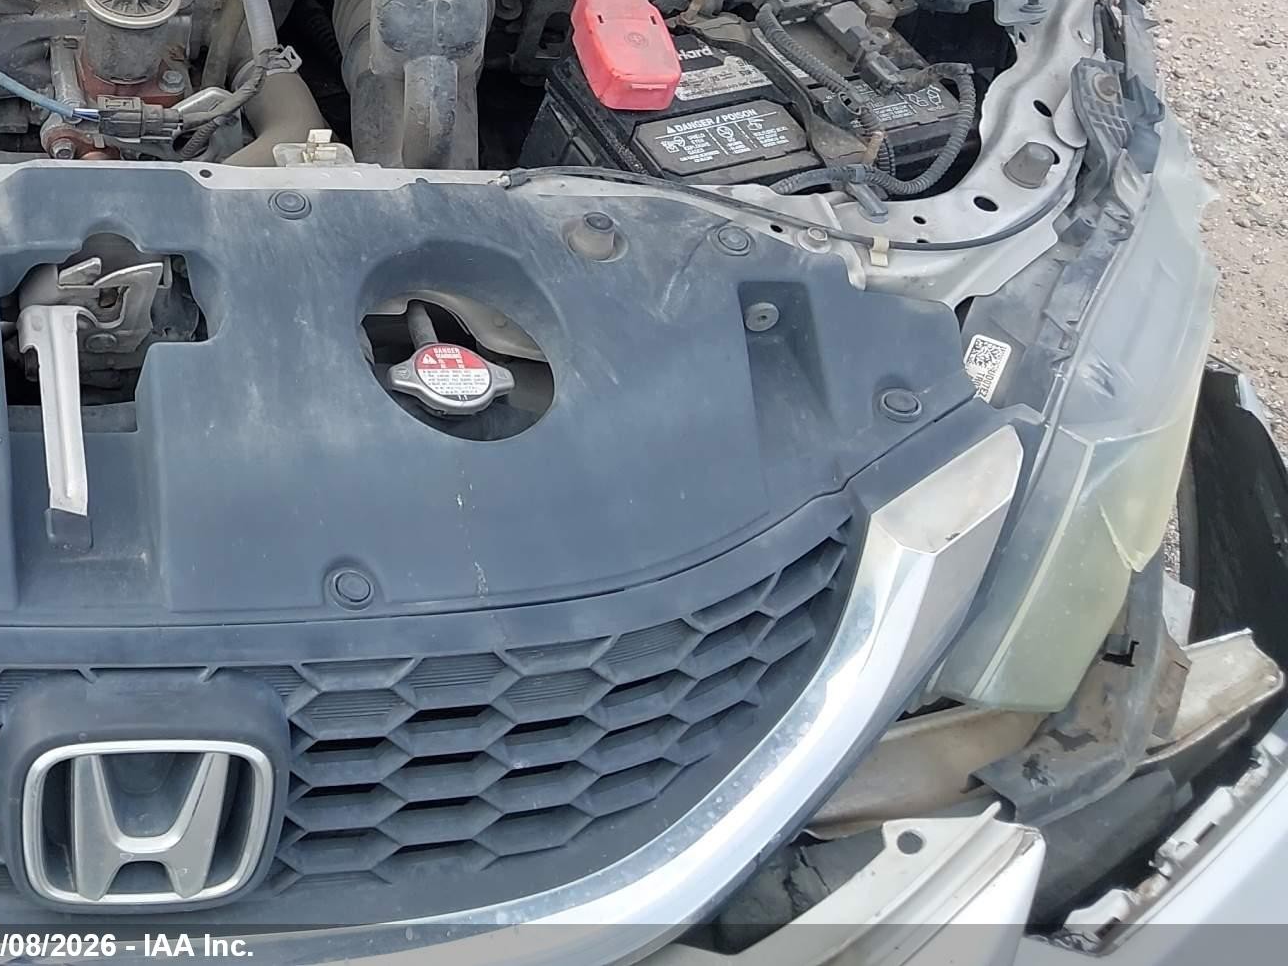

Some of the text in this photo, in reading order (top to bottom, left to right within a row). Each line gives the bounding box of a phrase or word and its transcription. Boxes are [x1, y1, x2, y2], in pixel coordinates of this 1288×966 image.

[678, 45, 714, 61] Hard
[673, 118, 715, 133] DANGER
[721, 109, 758, 123] POISON
